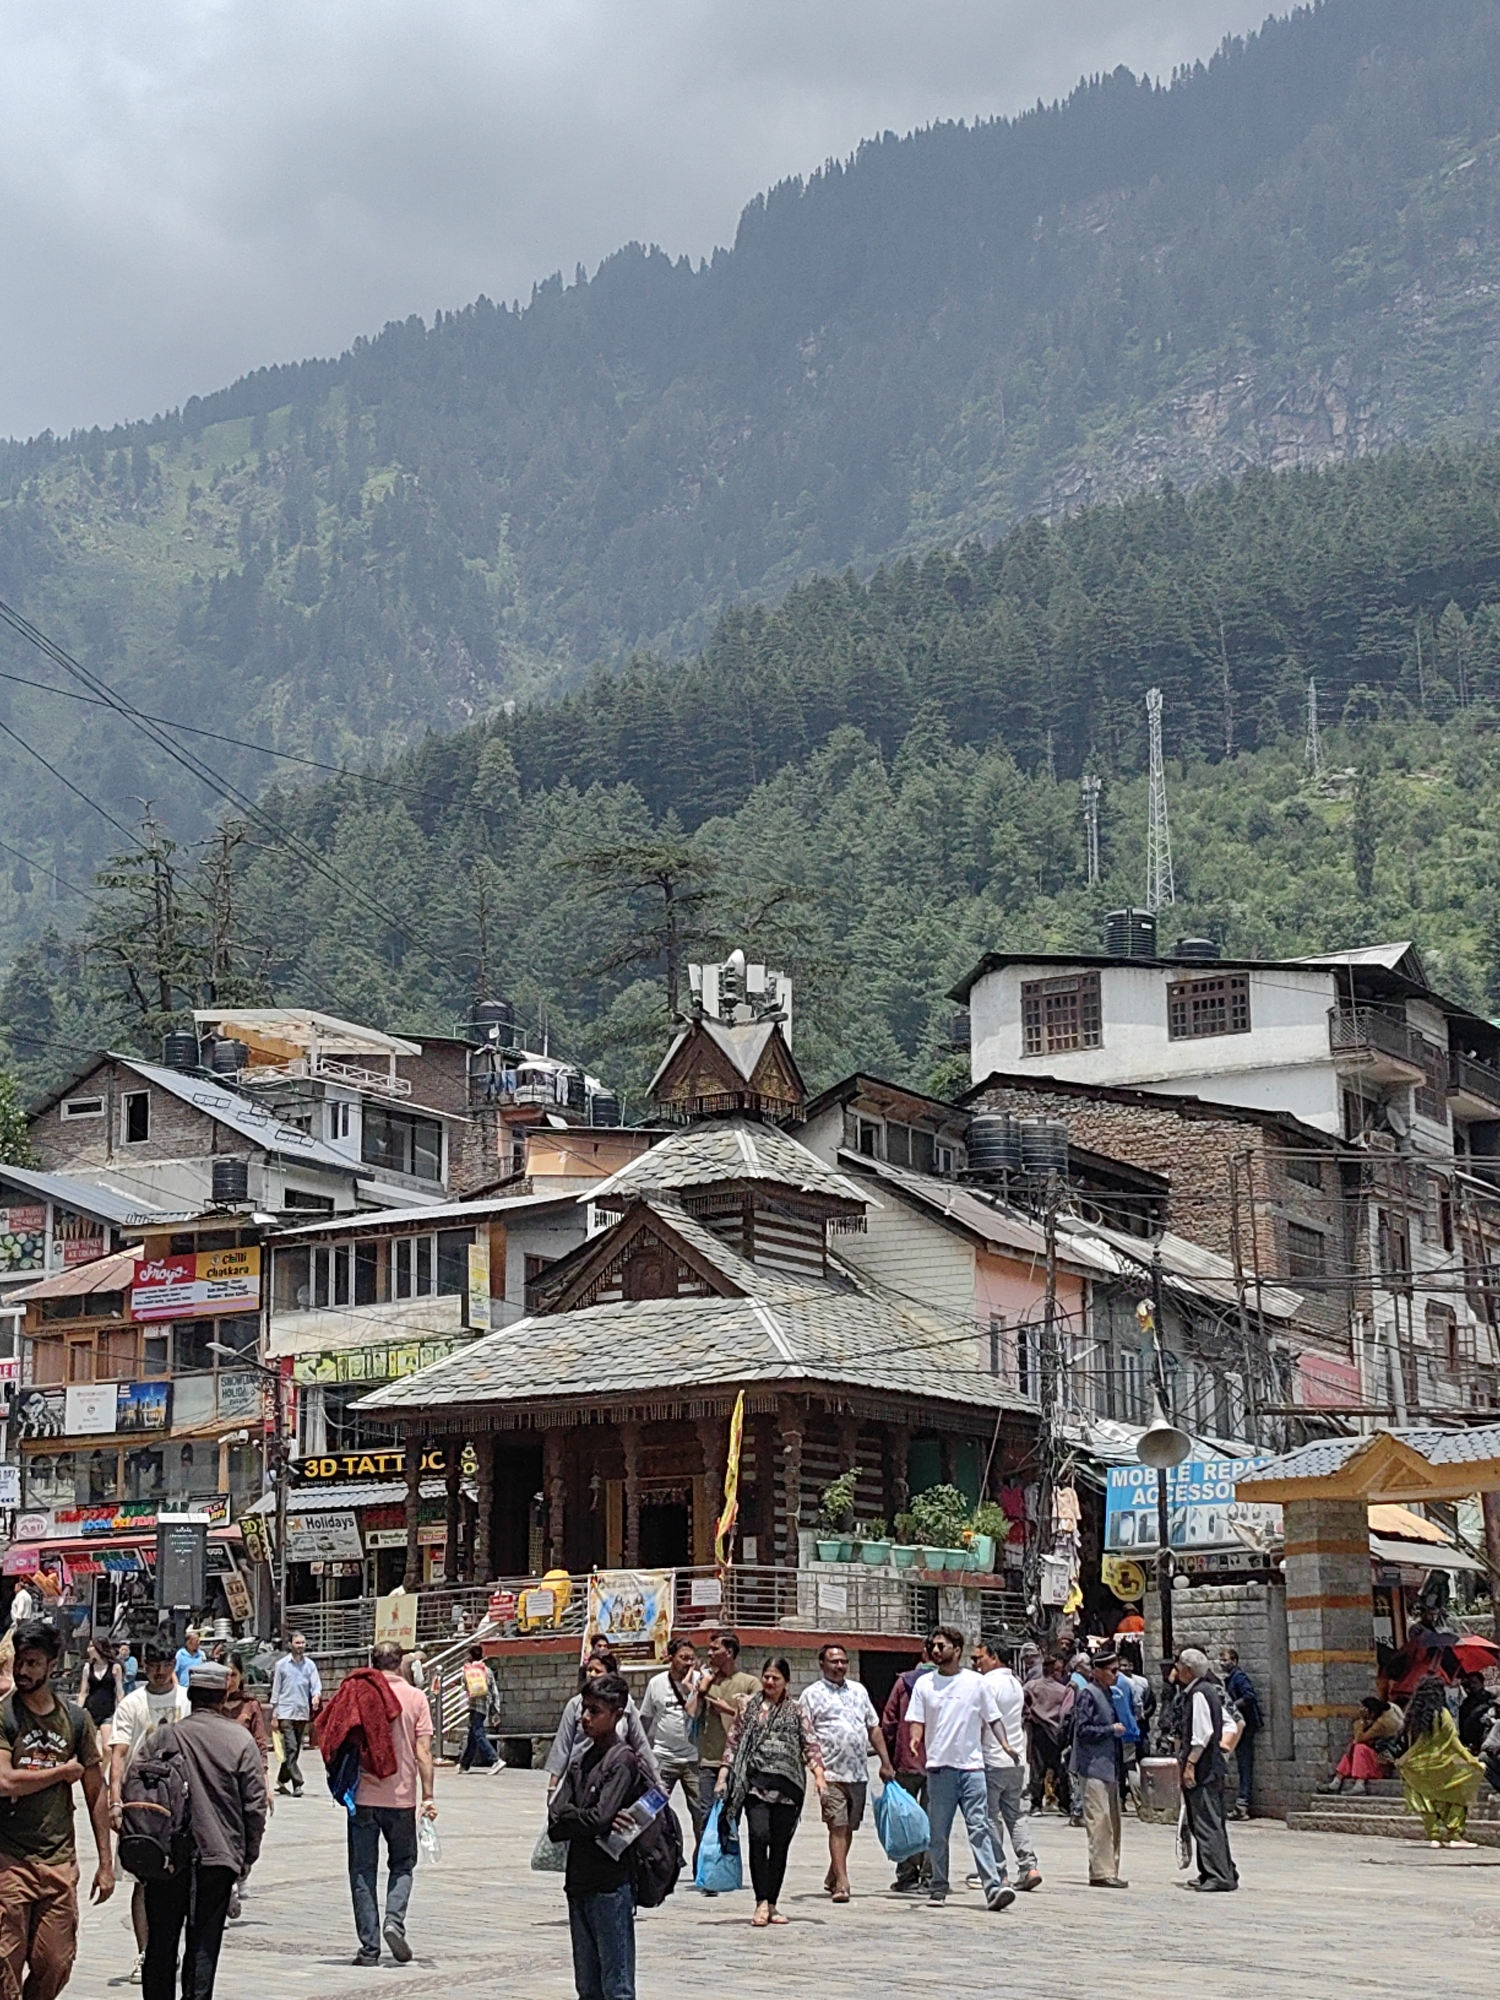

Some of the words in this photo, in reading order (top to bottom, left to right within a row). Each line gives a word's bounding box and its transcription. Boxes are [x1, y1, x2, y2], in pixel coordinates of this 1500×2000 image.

[304, 1459, 338, 1478] 3D
[1111, 1463, 1190, 1487] MOBLE
[241, 1519, 257, 1534] 3D
[305, 1514, 354, 1531] Holidays
